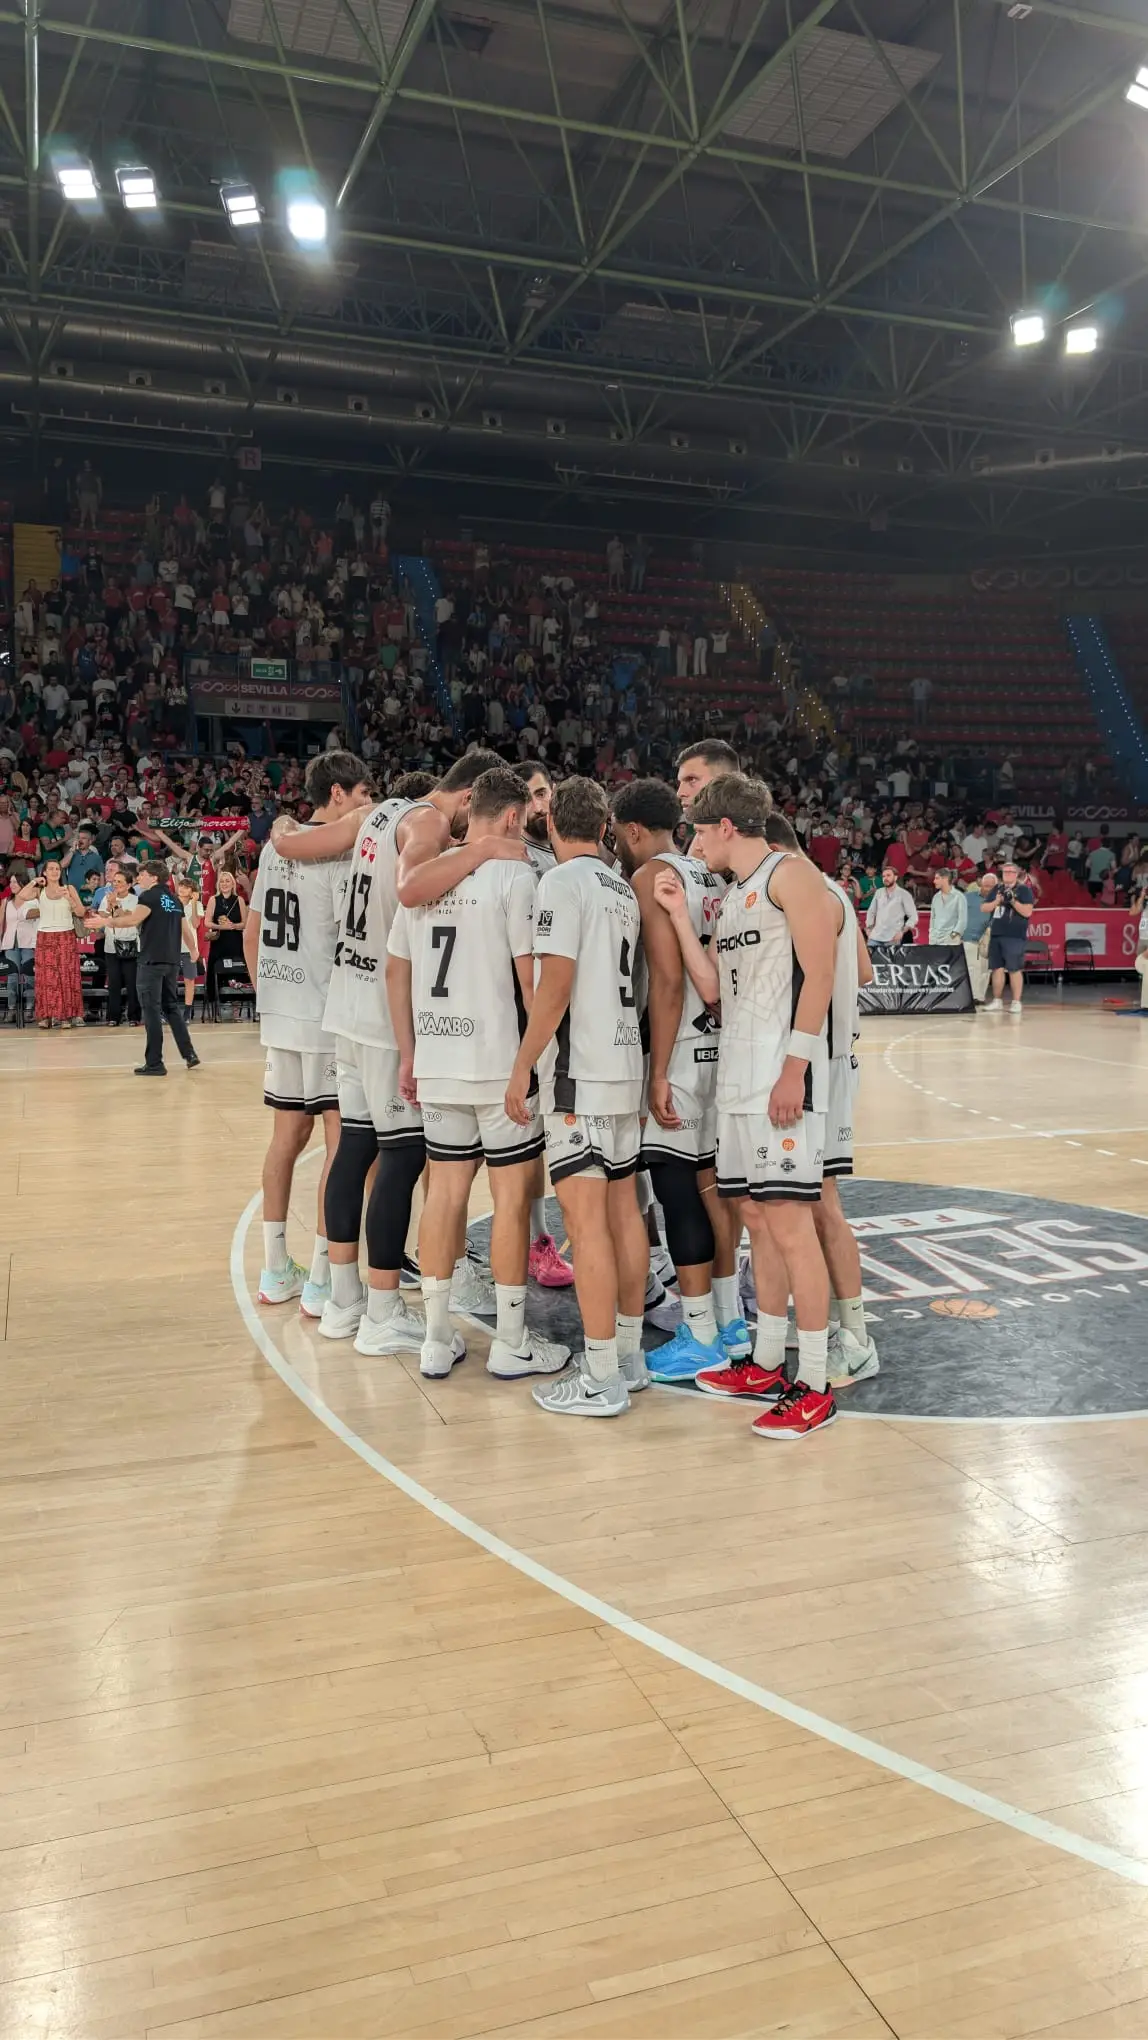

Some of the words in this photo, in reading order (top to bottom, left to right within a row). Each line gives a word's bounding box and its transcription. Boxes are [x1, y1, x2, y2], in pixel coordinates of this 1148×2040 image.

[240, 684, 289, 697] SEVILLA
[1008, 805, 1056, 818] EVILLA
[160, 817, 190, 829] Elijo
[262, 887, 301, 952] 99
[431, 926, 457, 998] 7
[864, 963, 953, 986] ERTAS
[697, 1050, 719, 1061] IBIZ
